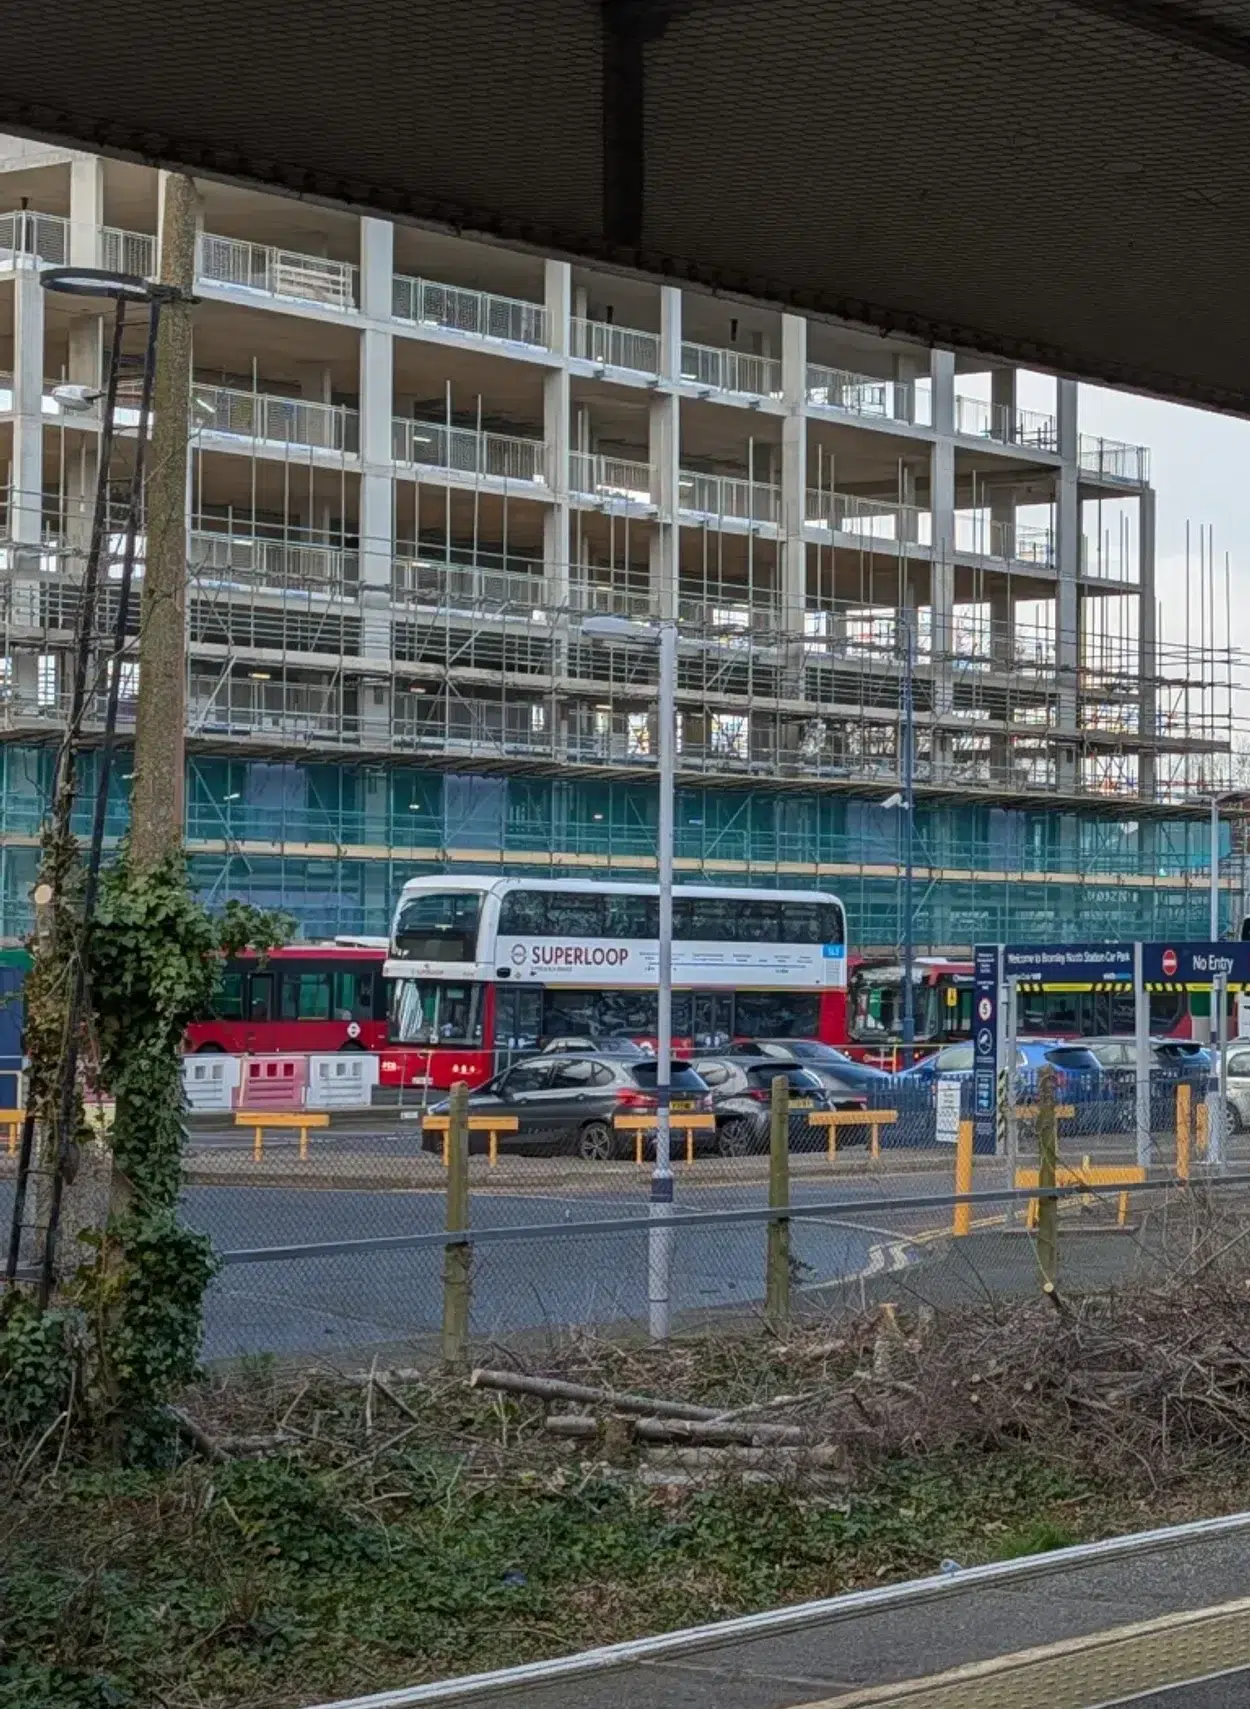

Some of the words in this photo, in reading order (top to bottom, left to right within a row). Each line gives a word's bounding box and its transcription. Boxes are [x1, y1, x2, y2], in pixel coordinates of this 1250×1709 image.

[531, 945, 629, 966] SUPERLOOP
[1008, 953, 1034, 964] Welcome
[1042, 952, 1065, 965] Bromley
[1066, 952, 1082, 963] North
[1083, 951, 1104, 963] Station
[1104, 951, 1116, 962] Car
[1116, 951, 1130, 962] Park
[1192, 955, 1207, 970] No
[1208, 954, 1234, 974] Entry
[982, 1002, 988, 1015] 5
